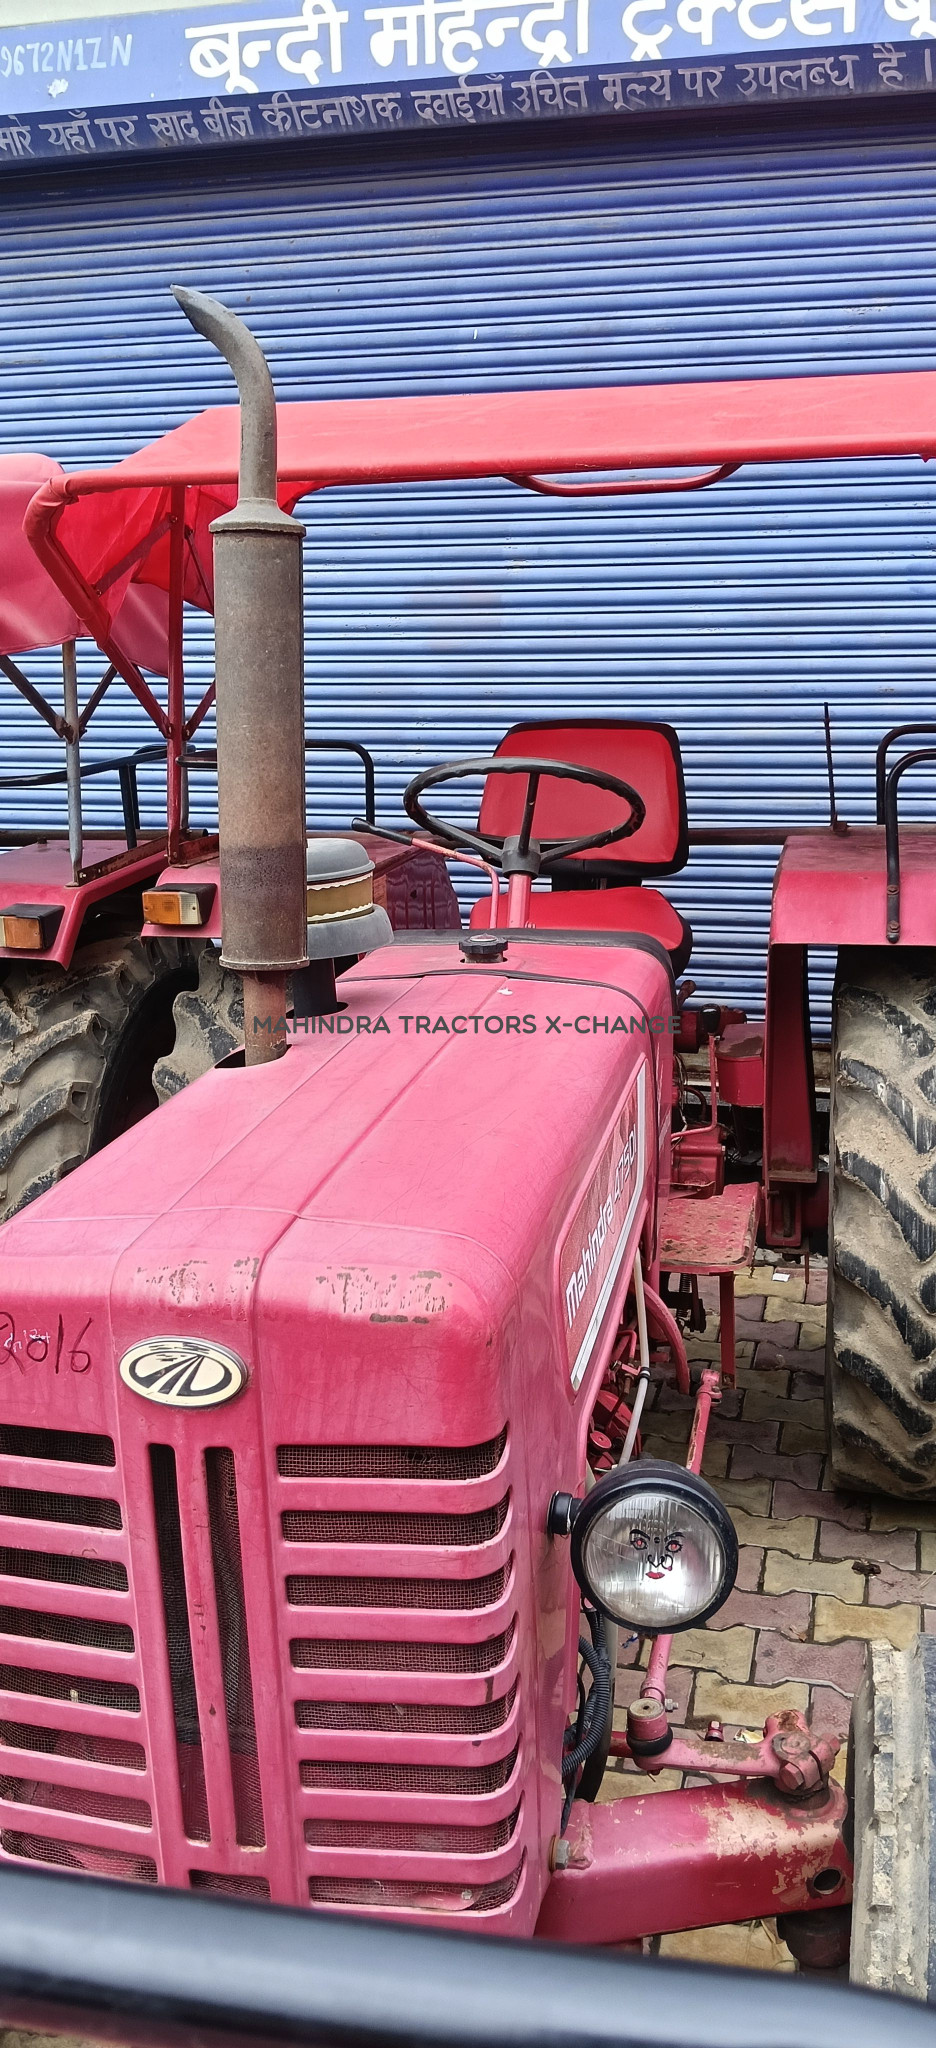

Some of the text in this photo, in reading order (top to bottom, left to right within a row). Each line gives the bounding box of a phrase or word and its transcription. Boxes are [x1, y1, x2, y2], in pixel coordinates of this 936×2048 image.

[38, 108, 96, 153] यहाँ
[94, 115, 139, 147] पर
[146, 110, 202, 144] खाद
[200, 96, 254, 137] बीज
[258, 91, 402, 133] कीटनाशक
[511, 70, 589, 112] उचित
[598, 69, 672, 111] मूल्य
[678, 65, 726, 98] पर
[735, 54, 859, 96] उपलब्ध
[872, 42, 907, 90] है
[565, 1191, 615, 1329] Mahindra
